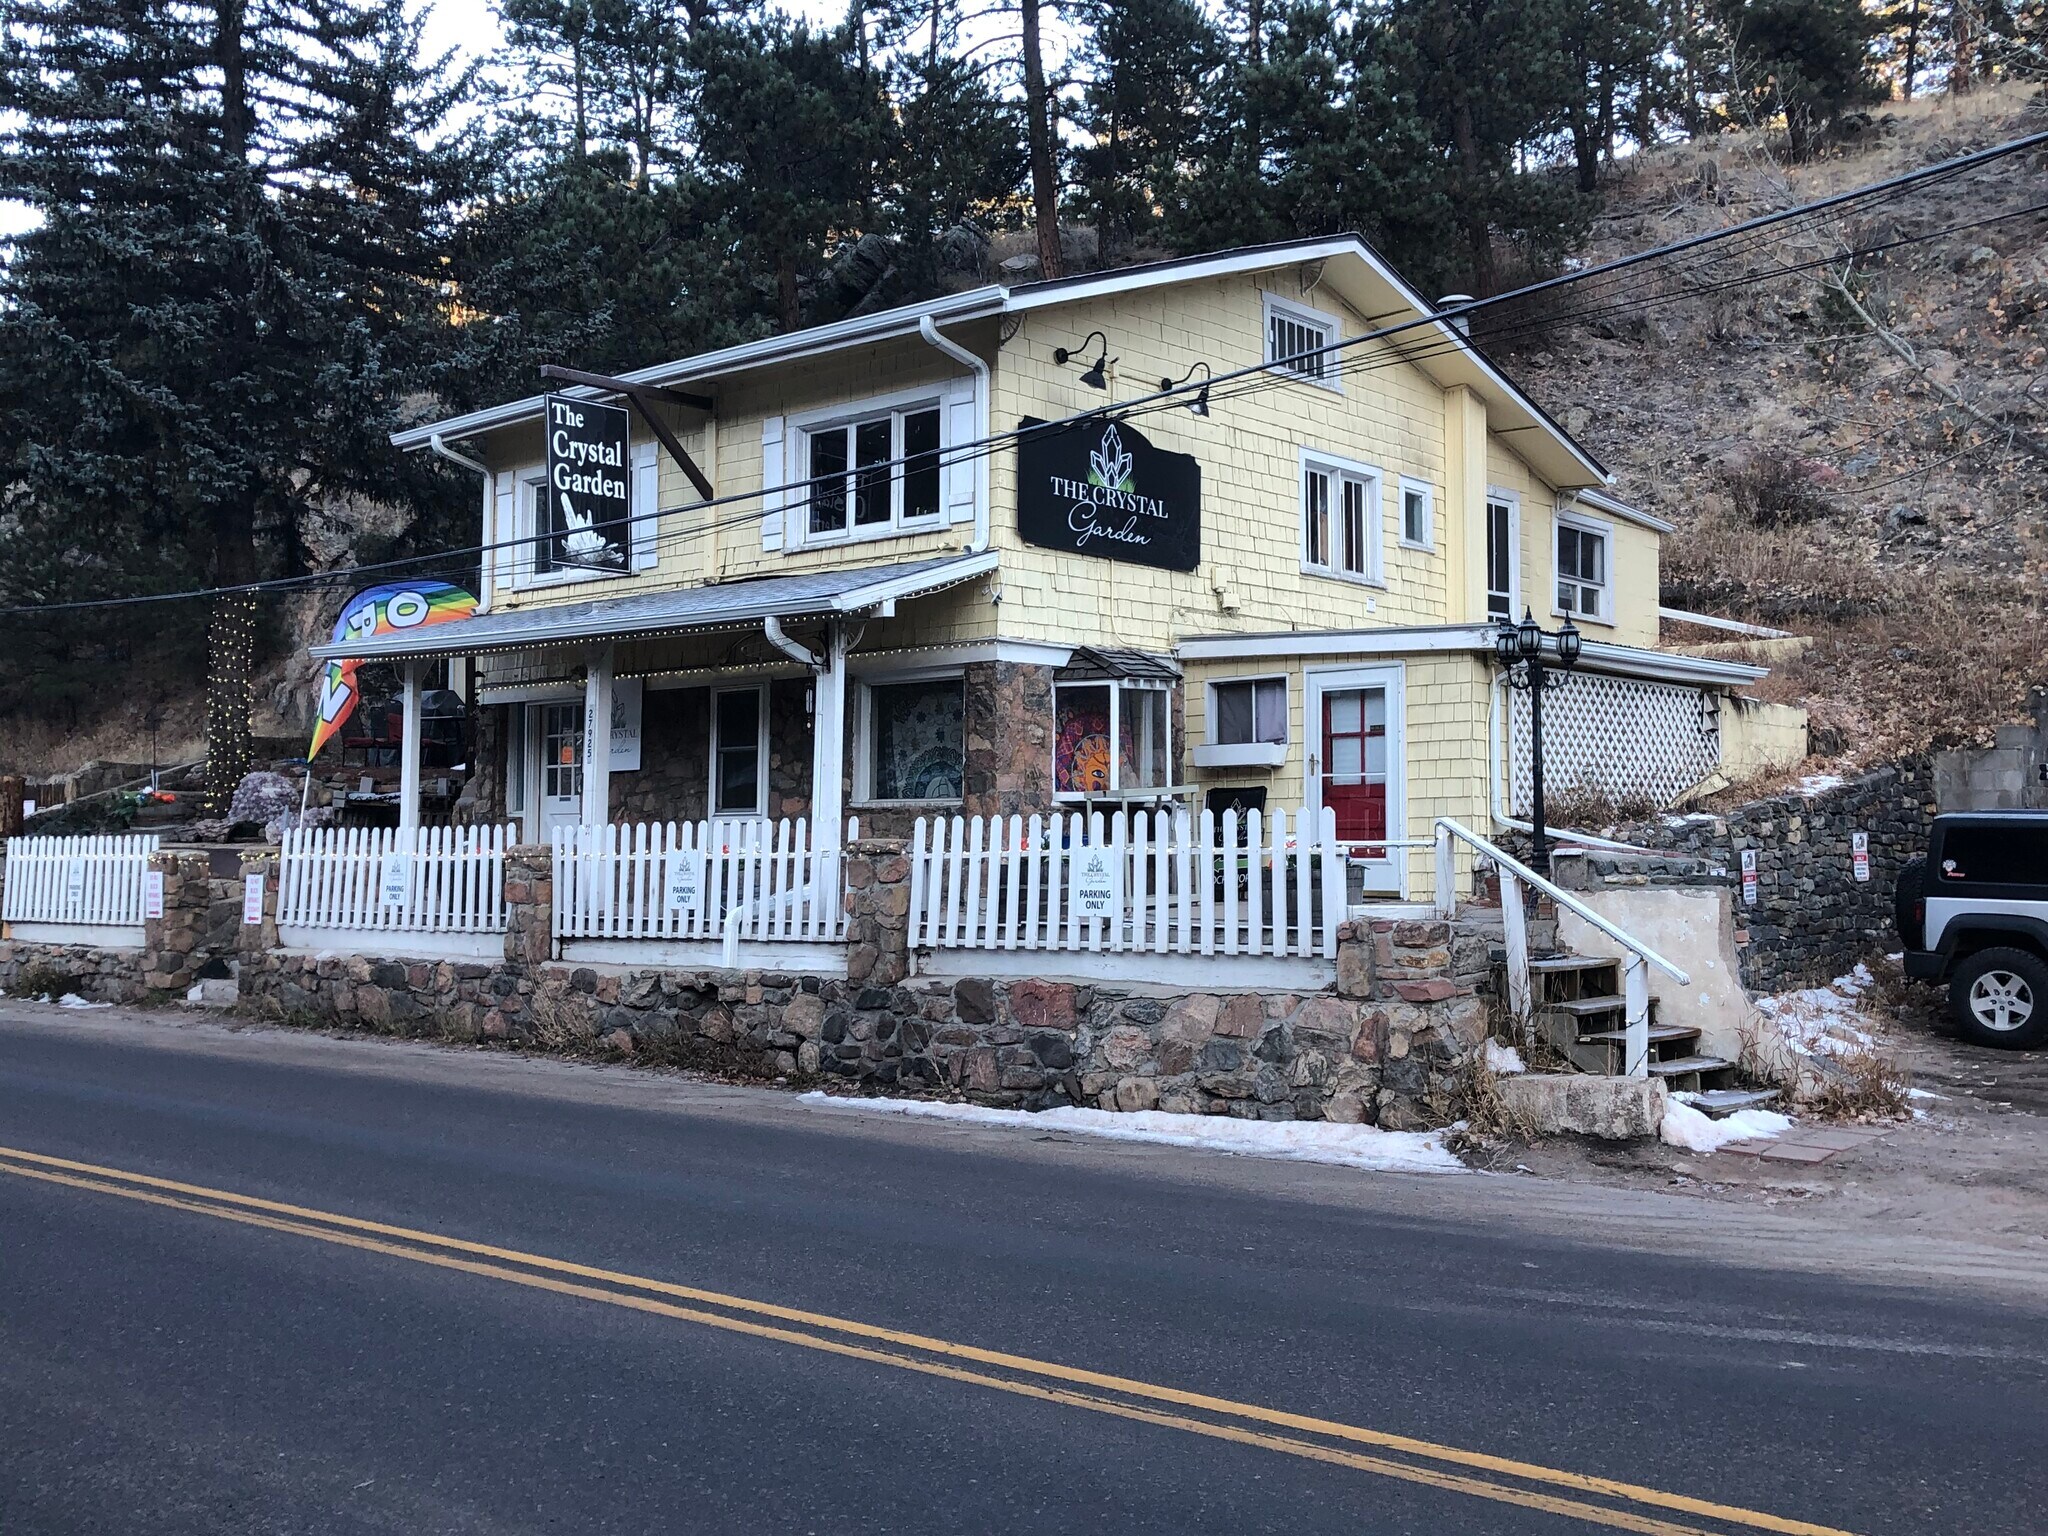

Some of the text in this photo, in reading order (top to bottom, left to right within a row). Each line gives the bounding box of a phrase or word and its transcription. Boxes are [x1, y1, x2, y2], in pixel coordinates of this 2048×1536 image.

[552, 402, 584, 428] The
[552, 430, 623, 468] Crystal
[553, 462, 626, 500] Garden
[1050, 476, 1169, 519] THE CRYSTAL
[1068, 500, 1152, 547] Garden
[587, 709, 595, 758] 27925
[610, 728, 637, 740] RYSTAL
[672, 886, 696, 895] PARKING
[676, 895, 691, 904] ONLY
[1079, 889, 1111, 899] PARKING
[1085, 900, 1105, 910] ONLY
